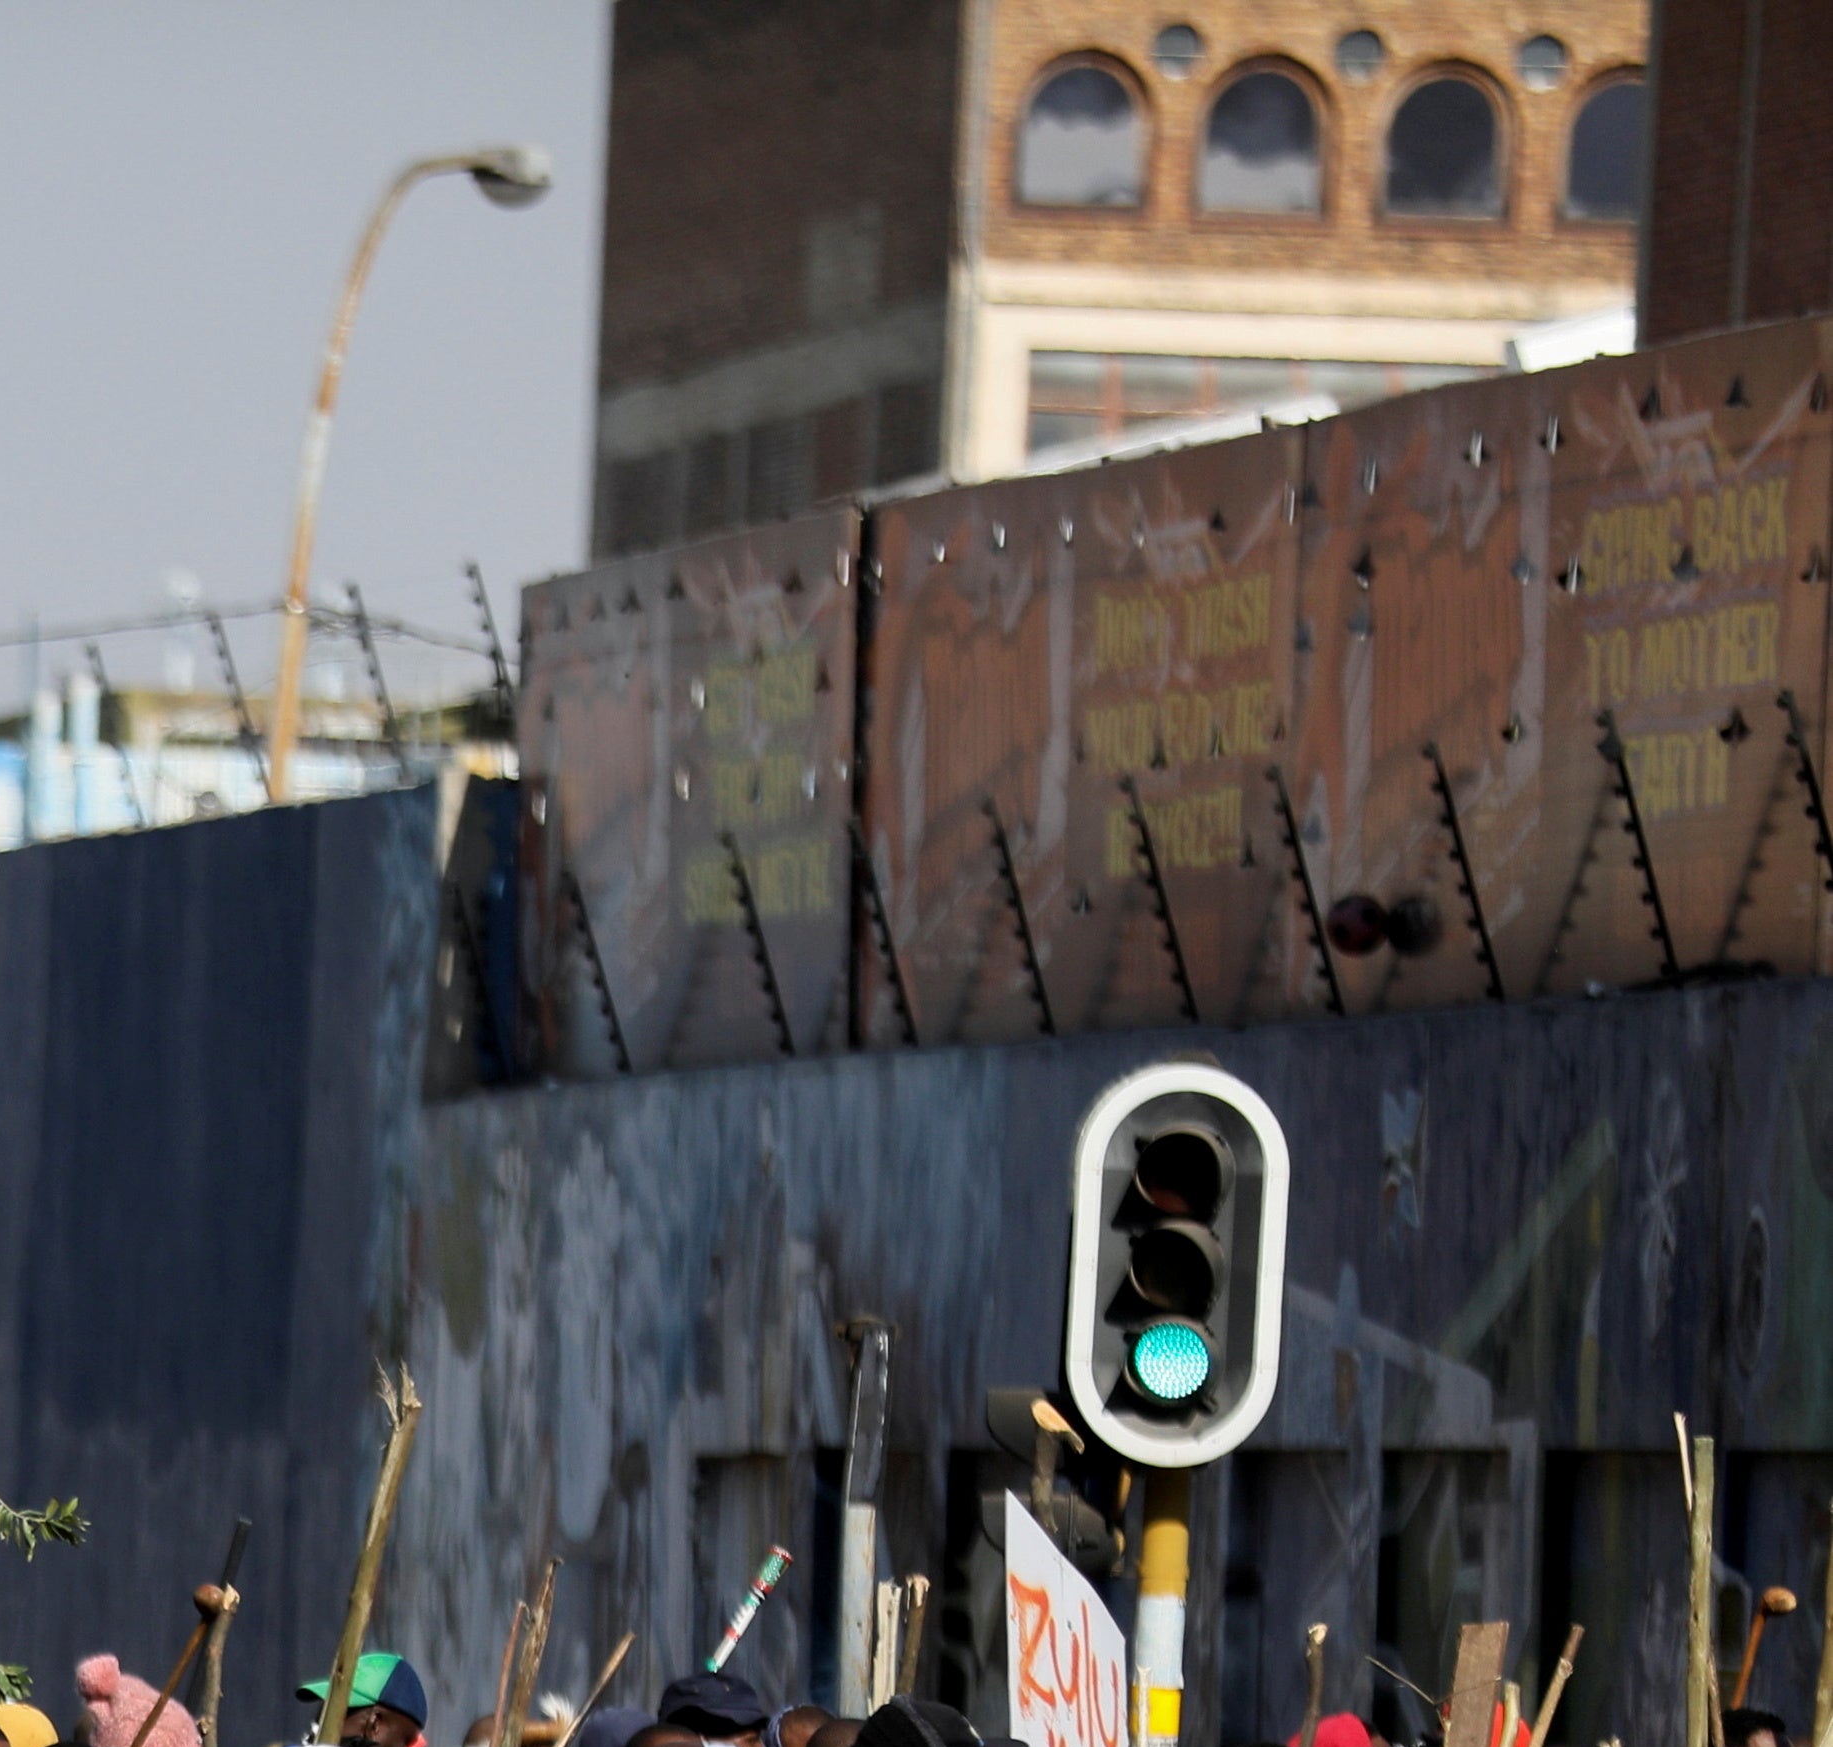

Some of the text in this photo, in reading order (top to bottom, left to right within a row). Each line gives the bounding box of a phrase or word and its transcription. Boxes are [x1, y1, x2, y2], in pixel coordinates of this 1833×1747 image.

[1583, 478, 1787, 597] GIVING BACK
[1585, 602, 1779, 706] TO MOTHER
